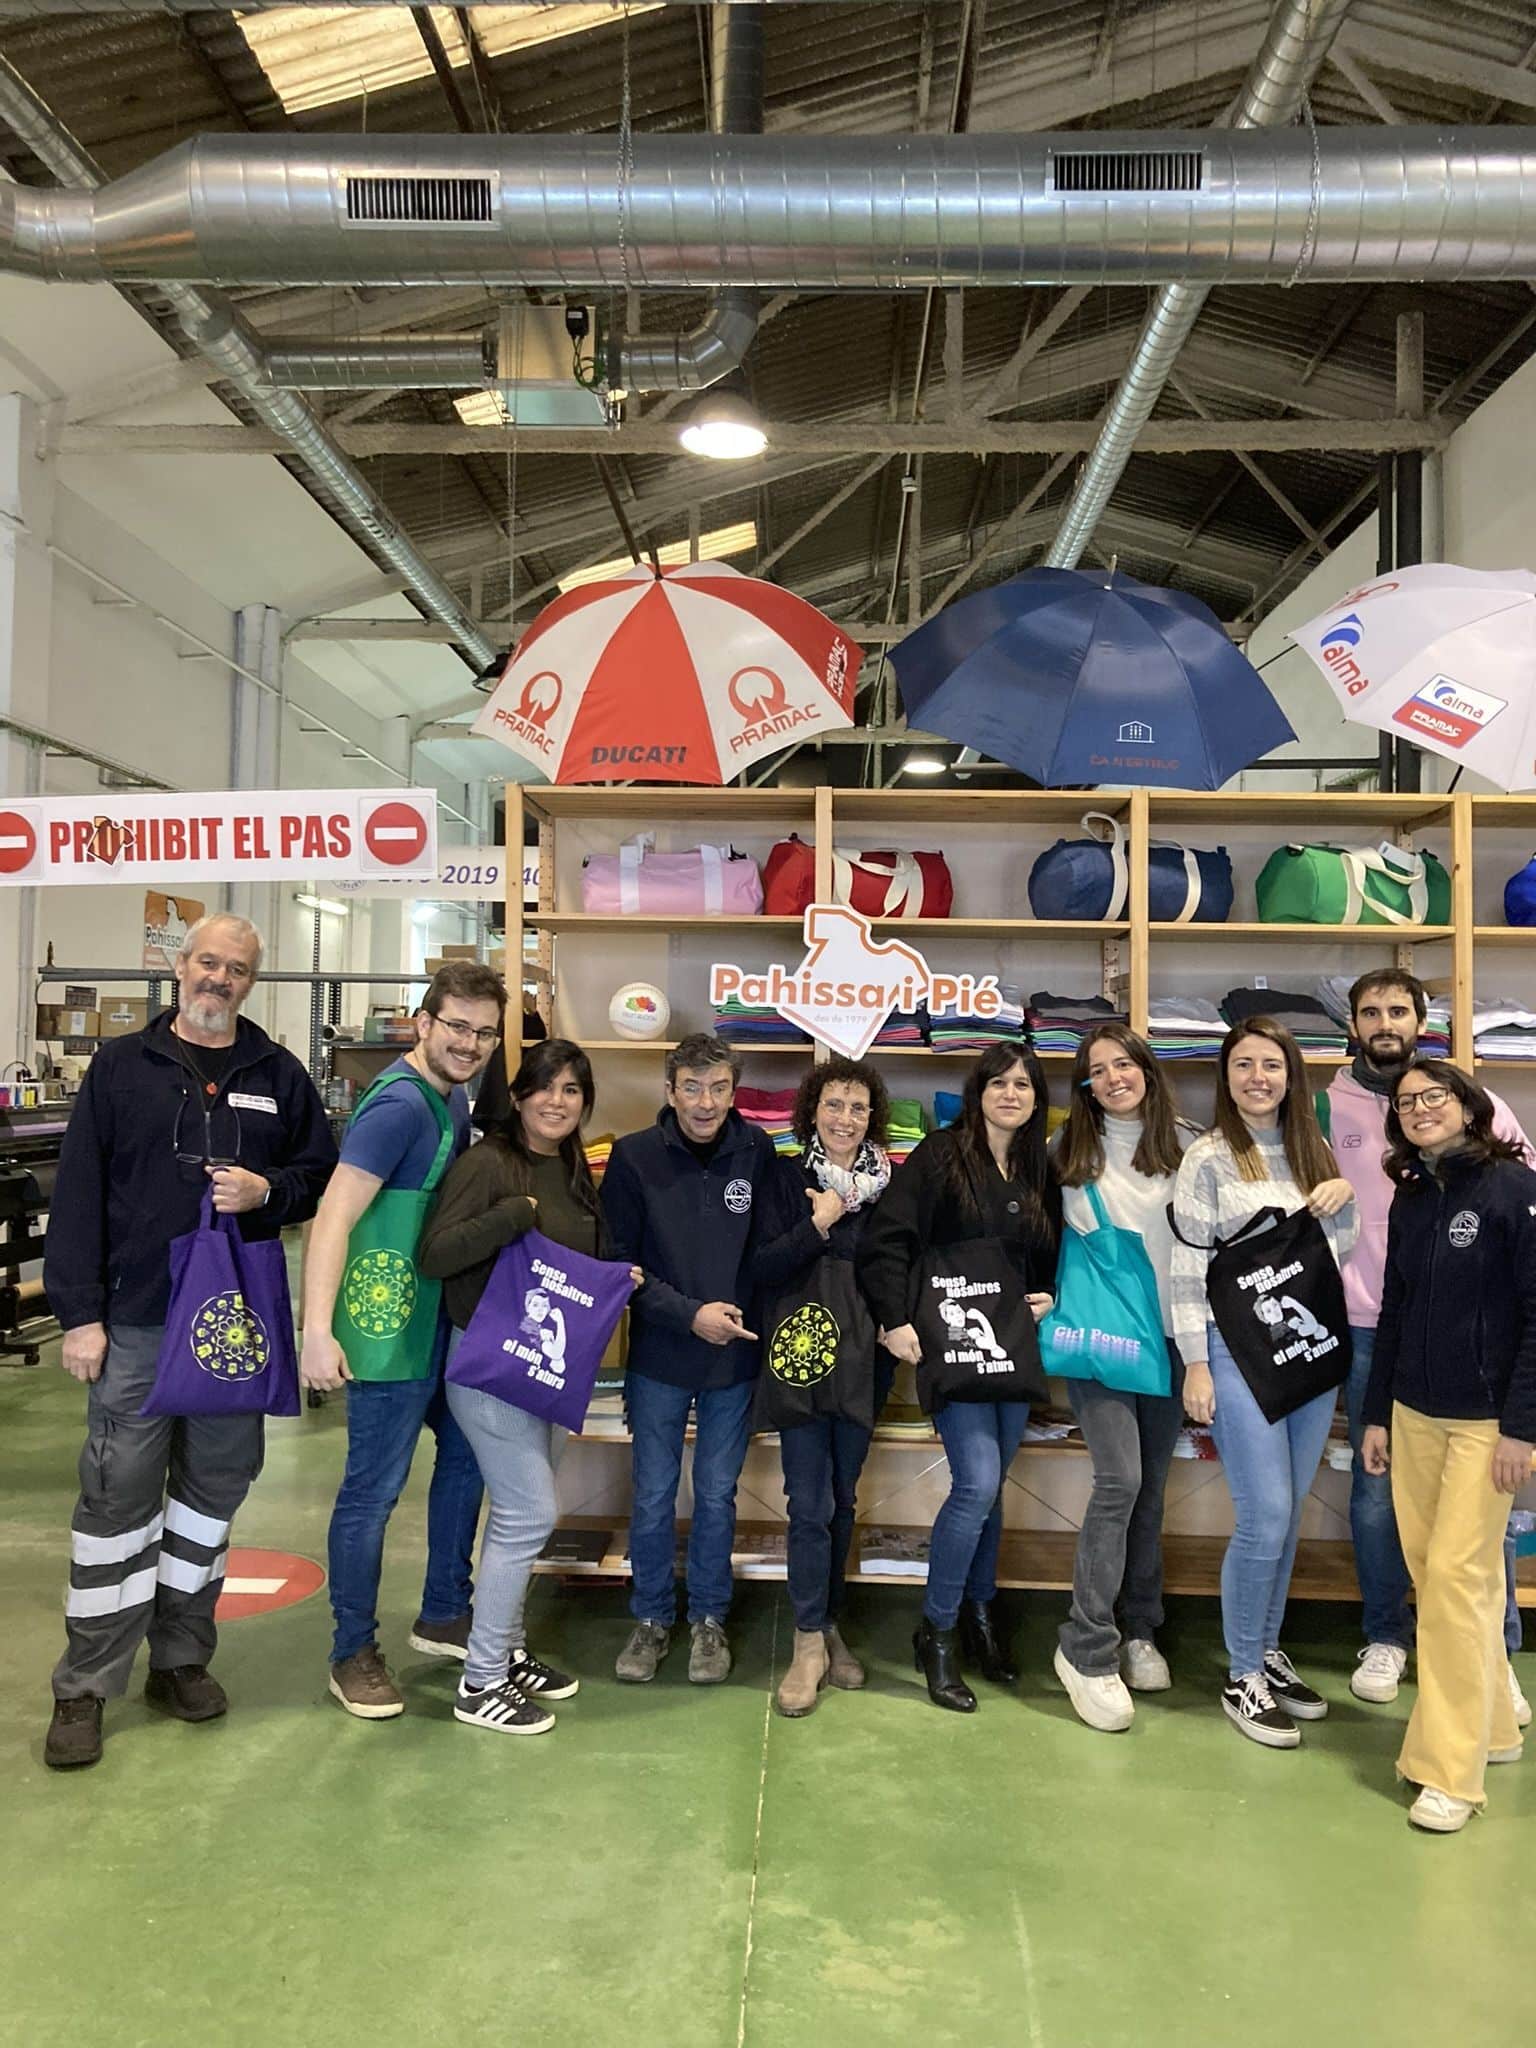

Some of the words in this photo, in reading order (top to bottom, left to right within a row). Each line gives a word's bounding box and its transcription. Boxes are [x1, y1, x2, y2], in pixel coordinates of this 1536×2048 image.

[1323, 646, 1369, 697] alma
[1442, 694, 1486, 719] alma
[494, 709, 555, 754] PRAMAC
[730, 704, 821, 754] PRAMAC
[1410, 710, 1462, 736] PRAMAC
[591, 746, 687, 765] DUCATI
[50, 817, 223, 864] PRHIBIT
[233, 816, 271, 860] EL
[280, 814, 352, 859] PAS
[715, 968, 887, 1009] Pahissa
[932, 977, 999, 1015] Pié
[531, 1259, 567, 1283] Sense
[931, 1275, 967, 1289] Sense
[1237, 1265, 1274, 1290] Sense
[1255, 1261, 1304, 1294] nosaltres
[541, 1276, 595, 1308] nosaltres
[946, 1282, 1001, 1299] nosaltres
[503, 1339, 516, 1354] el
[1054, 1326, 1086, 1348] Girl
[1304, 1336, 1339, 1362] s'atura
[944, 1351, 956, 1364] el
[977, 1360, 1015, 1375] s'atura
[1273, 1350, 1287, 1365] el
[527, 1363, 566, 1391] s'atura
